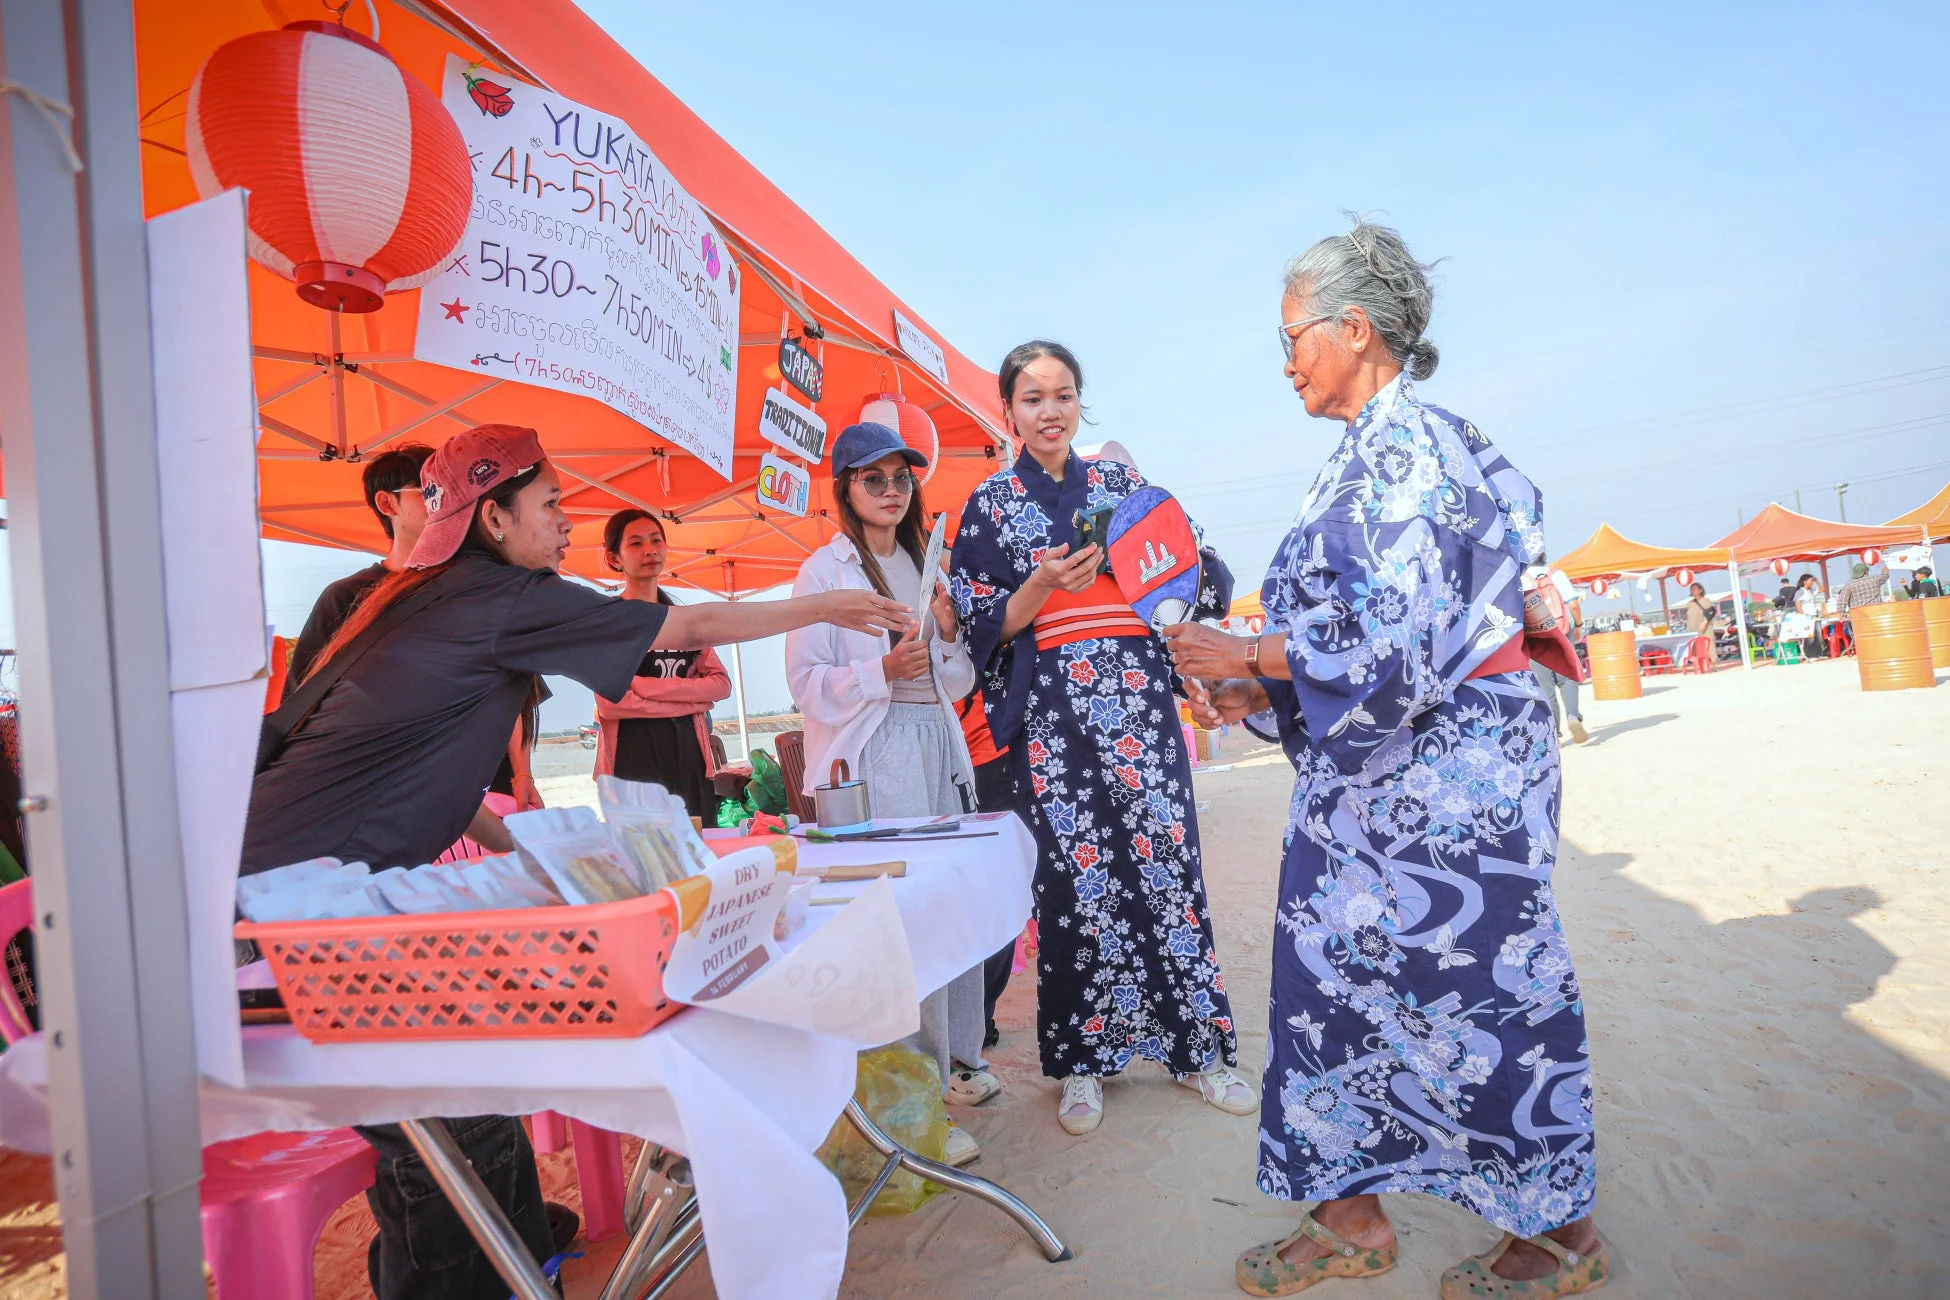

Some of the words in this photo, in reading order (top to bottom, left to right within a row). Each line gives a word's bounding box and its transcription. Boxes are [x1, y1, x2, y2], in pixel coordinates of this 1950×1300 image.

[543, 102, 657, 204] YUKATA
[782, 343, 823, 399] JAPAN
[765, 399, 824, 459] TRADITIONAL
[759, 465, 808, 512] CLOTH
[734, 862, 760, 886] DRY
[706, 881, 775, 921] JAPANESE
[709, 910, 756, 944] SWEET
[702, 934, 747, 977] POTATO
